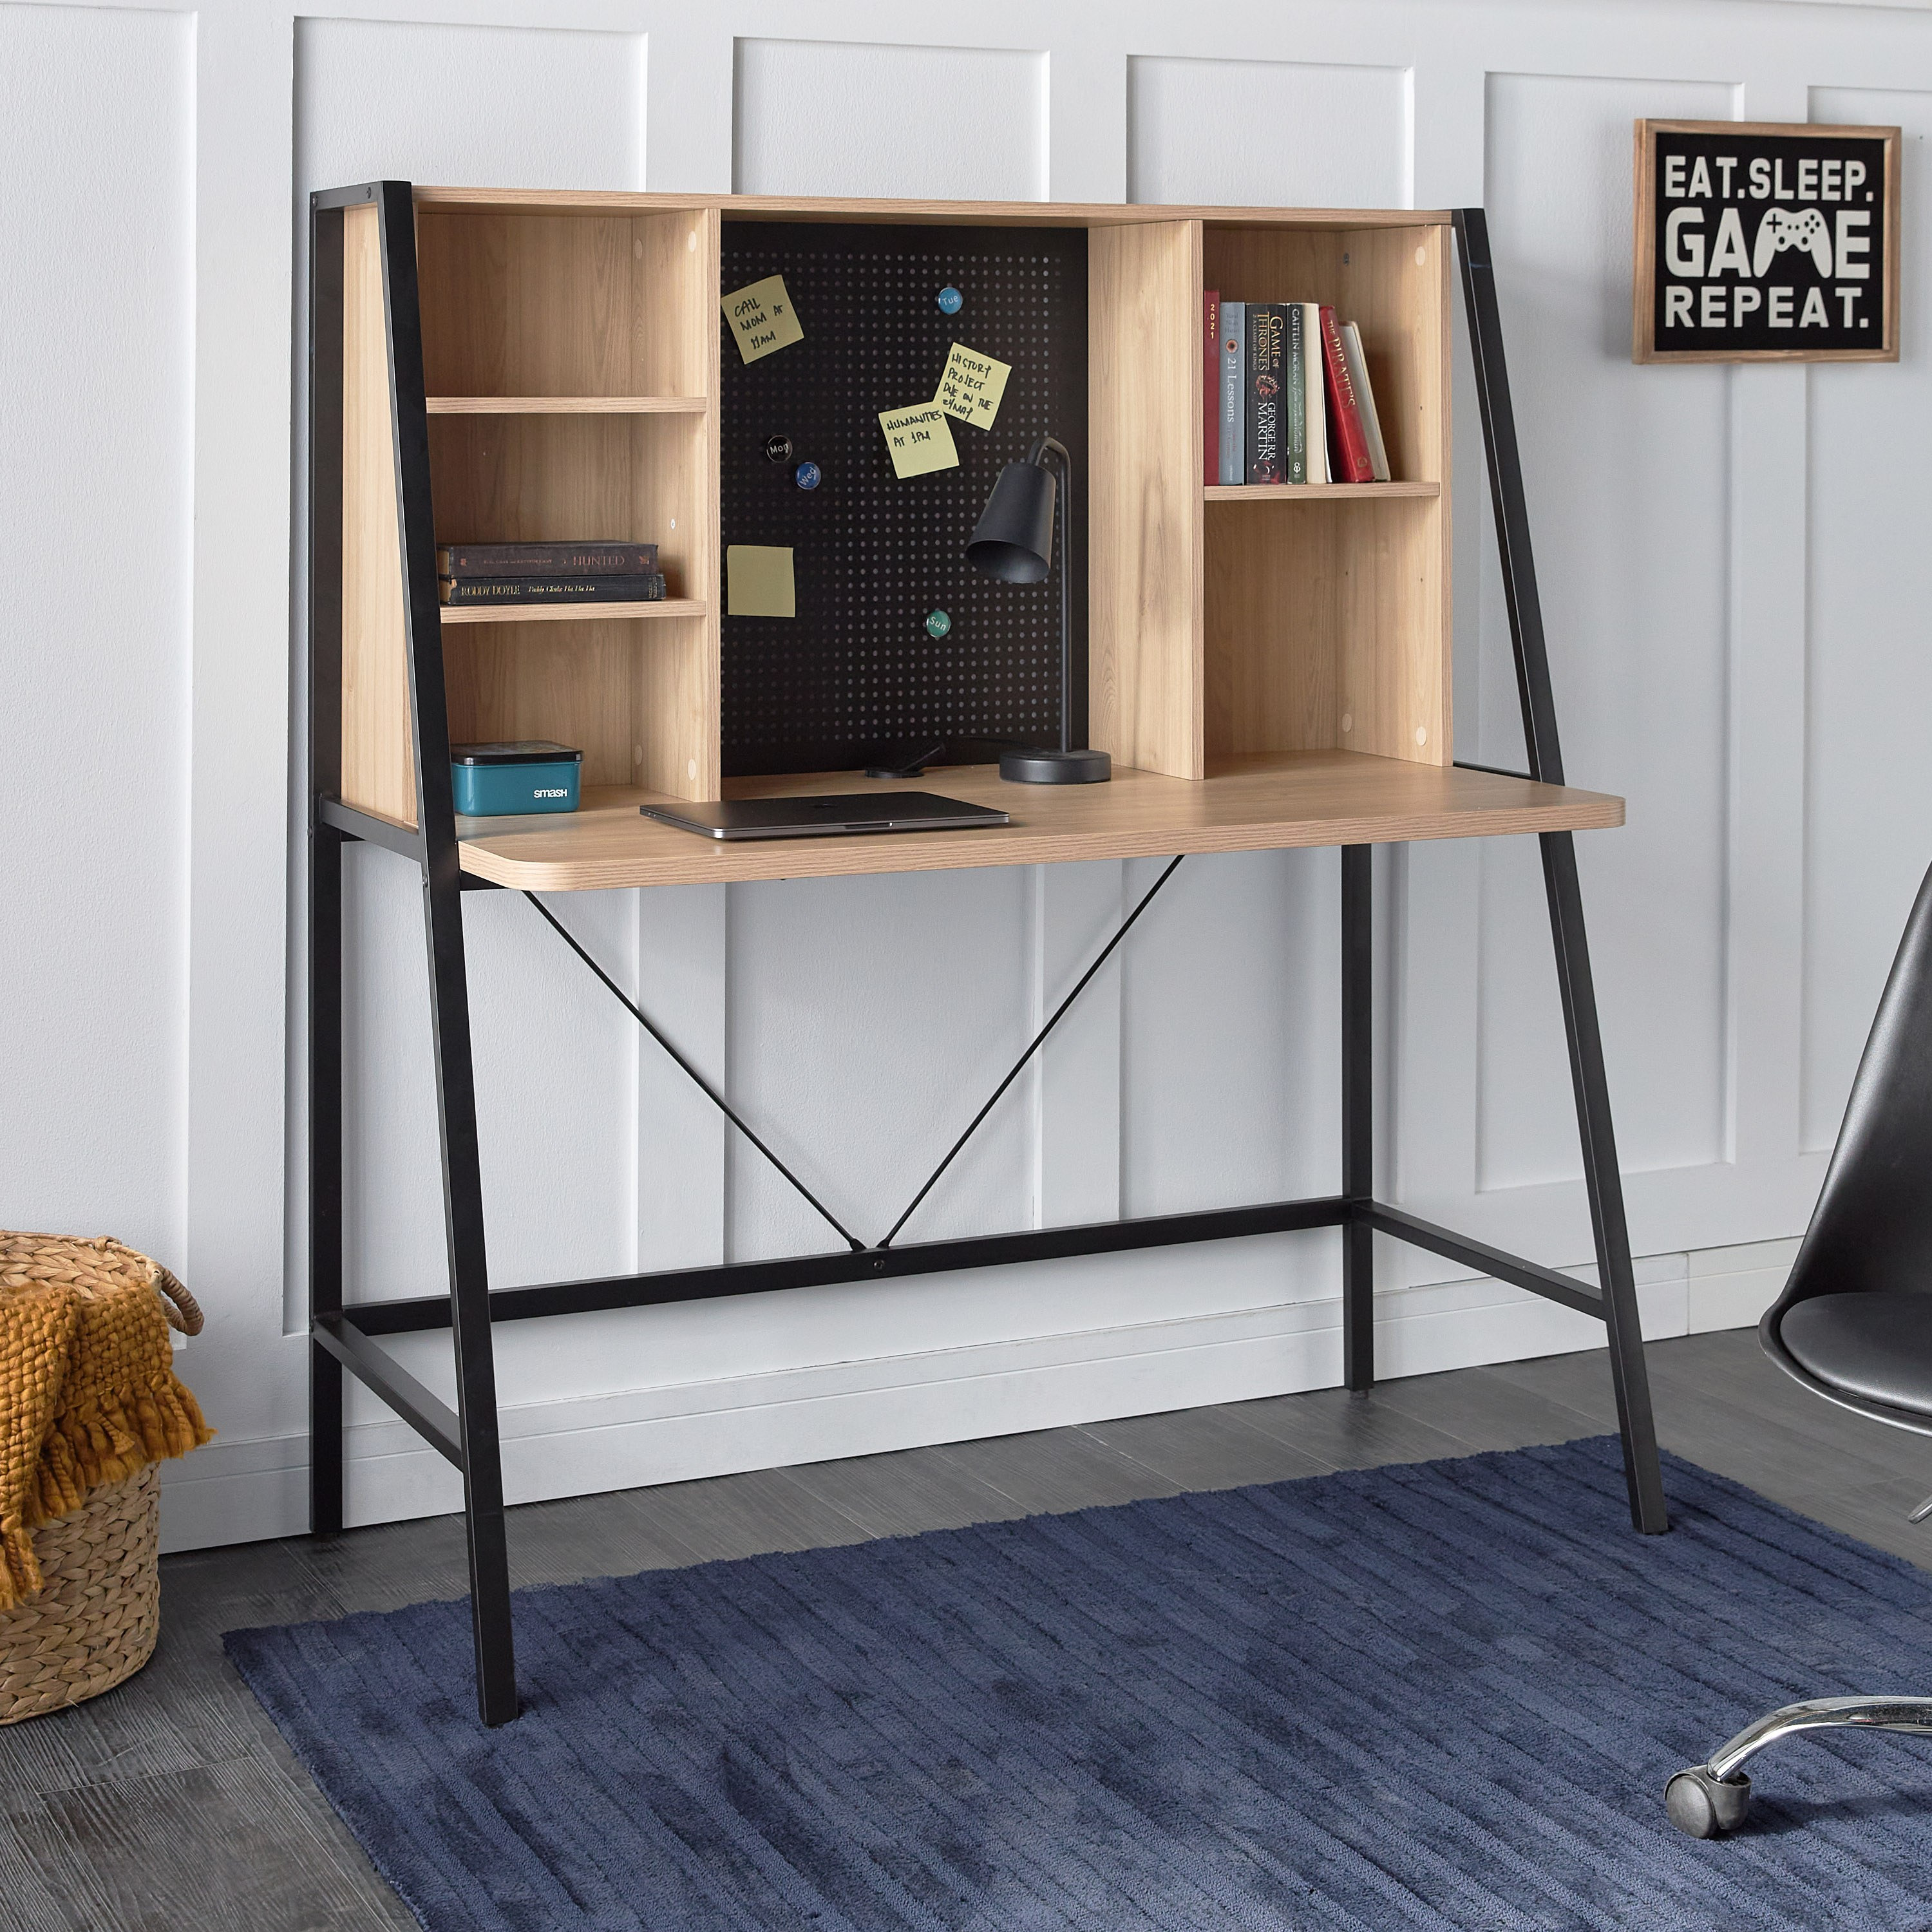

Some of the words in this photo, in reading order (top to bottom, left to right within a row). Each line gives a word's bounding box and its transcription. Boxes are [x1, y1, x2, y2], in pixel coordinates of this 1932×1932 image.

[735, 298, 761, 317] CALL
[942, 296, 958, 306] Tue
[1665, 285, 1870, 329] REPEAT.
[740, 312, 767, 331] MOM
[773, 305, 783, 316] AT
[1292, 308, 1300, 350] CAITLIN
[1327, 319, 1336, 336] THE
[1257, 312, 1270, 371] THRONES
[1269, 316, 1283, 357] GAME
[951, 353, 992, 379] HISTORY
[1227, 357, 1236, 370] 21
[1273, 358, 1280, 368] OF
[947, 367, 985, 391] PROJECT
[943, 383, 959, 397] DUE
[963, 393, 973, 402] ON
[978, 397, 994, 410] TUE
[1227, 375, 1236, 422] Lessons
[1258, 402, 1268, 460] MARTIN
[1267, 402, 1276, 442] GEORGE
[770, 443, 789, 455] Mon
[893, 437, 905, 447] AT
[911, 431, 931, 444] 1PM
[800, 466, 817, 486] Wed
[461, 586, 491, 596] RODDY
[493, 585, 520, 595] DOYLE
[929, 616, 946, 631] Sun
